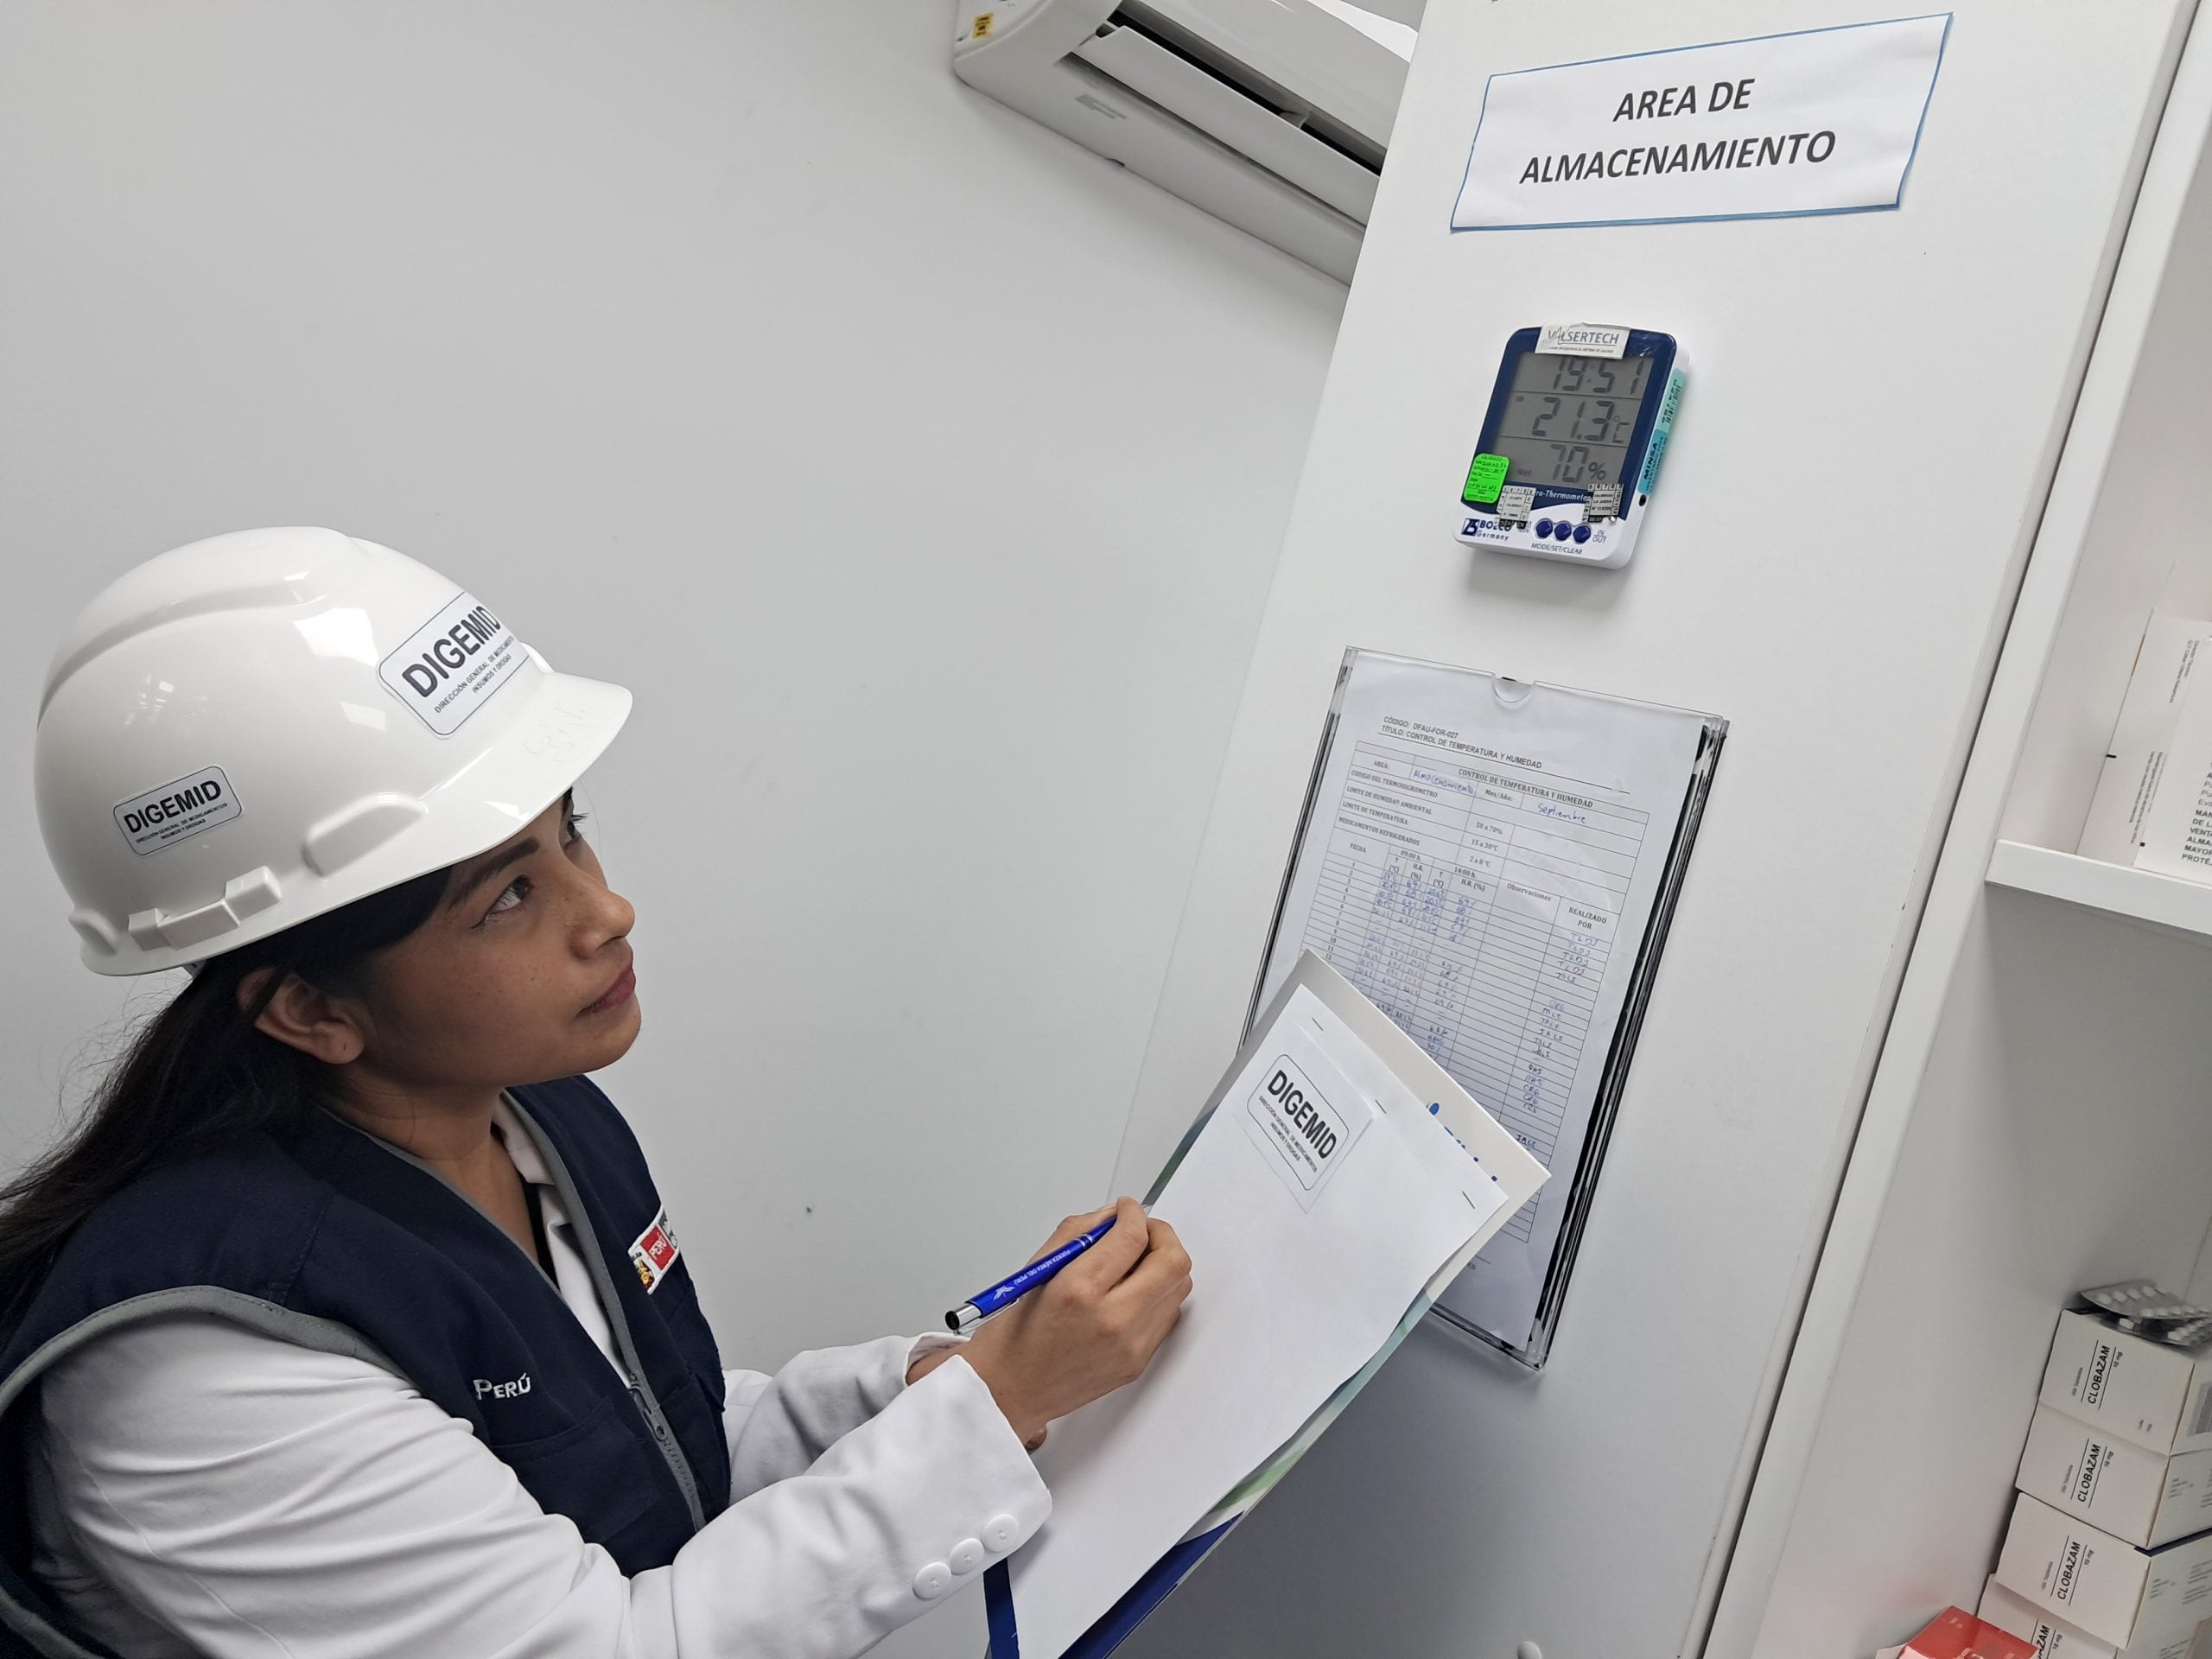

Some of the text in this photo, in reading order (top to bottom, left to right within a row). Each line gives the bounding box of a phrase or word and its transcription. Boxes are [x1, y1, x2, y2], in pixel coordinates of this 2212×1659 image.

[1613, 78, 1755, 122] AREA DE
[1519, 130, 1836, 184] ALMACENAMIENTO
[1643, 442, 1658, 481] MINSA
[1477, 531, 1510, 541] Germany
[402, 606, 501, 697] DIGEMID
[435, 681, 468, 713] DIRECCIÓN
[467, 661, 490, 683] GENERAL
[472, 670, 495, 693] INSUMOS
[1406, 731, 1437, 744] CONTROL
[1437, 738, 1448, 747] DE
[1448, 741, 1498, 760] TEMPERATURA
[1505, 754, 1543, 769] HUMEDAD
[124, 780, 221, 833] DIGEMID
[1372, 793, 1401, 806] HUMEDAD
[1400, 801, 1433, 816] AMBIENTAL
[1458, 768, 1489, 782] CONTROL
[1489, 776, 1498, 785] DE
[1499, 779, 1550, 798] TEMPERATURA
[1556, 792, 1593, 809] HUMEDAD
[1369, 808, 1408, 826] TEMPERATURA
[1350, 842, 1367, 854] FECHA
[1507, 882, 1552, 902] Observaciones
[1568, 906, 1607, 925] REALIZADO
[1578, 919, 1592, 930] POR
[1268, 1070, 1337, 1159] DIGEMID
[648, 1232, 667, 1258] PERÚ
[2088, 1345, 2111, 1404] CLOBAZAM
[2077, 1443, 2101, 1503] CLOBAZAM
[2056, 1541, 2081, 1600] CLOBAZAM
